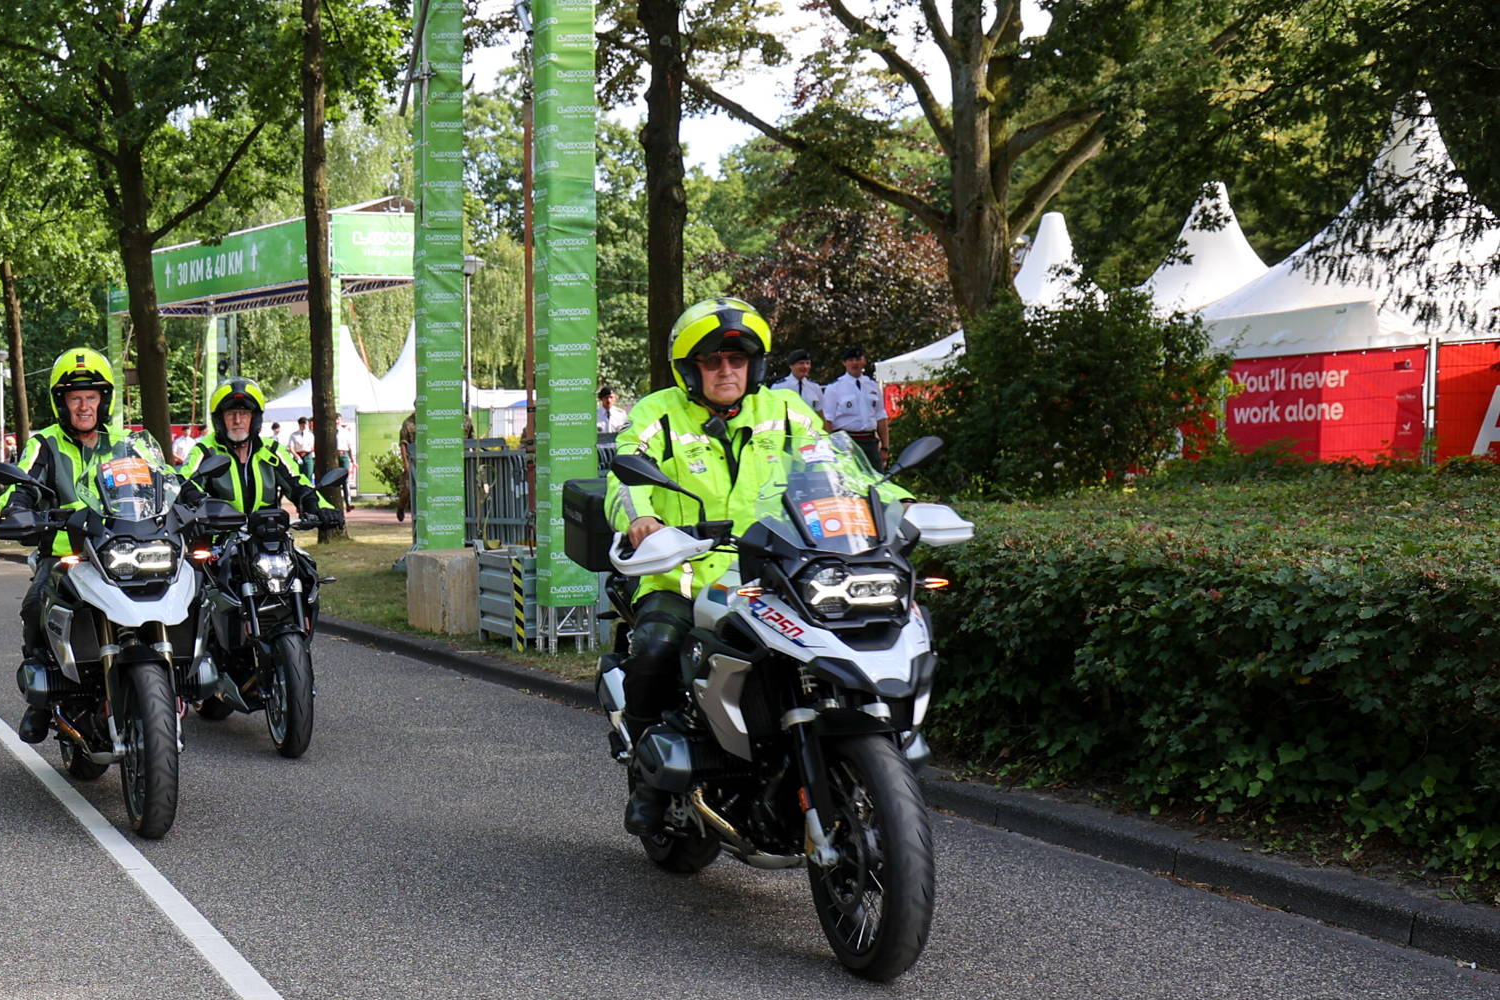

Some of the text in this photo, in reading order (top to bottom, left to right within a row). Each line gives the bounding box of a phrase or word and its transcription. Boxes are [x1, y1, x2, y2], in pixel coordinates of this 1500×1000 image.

[352, 231, 414, 245] LOW
[177, 250, 244, 286] 30 KM & 40 KM
[1235, 368, 1349, 392] You'll never
[1234, 398, 1344, 424] work alone
